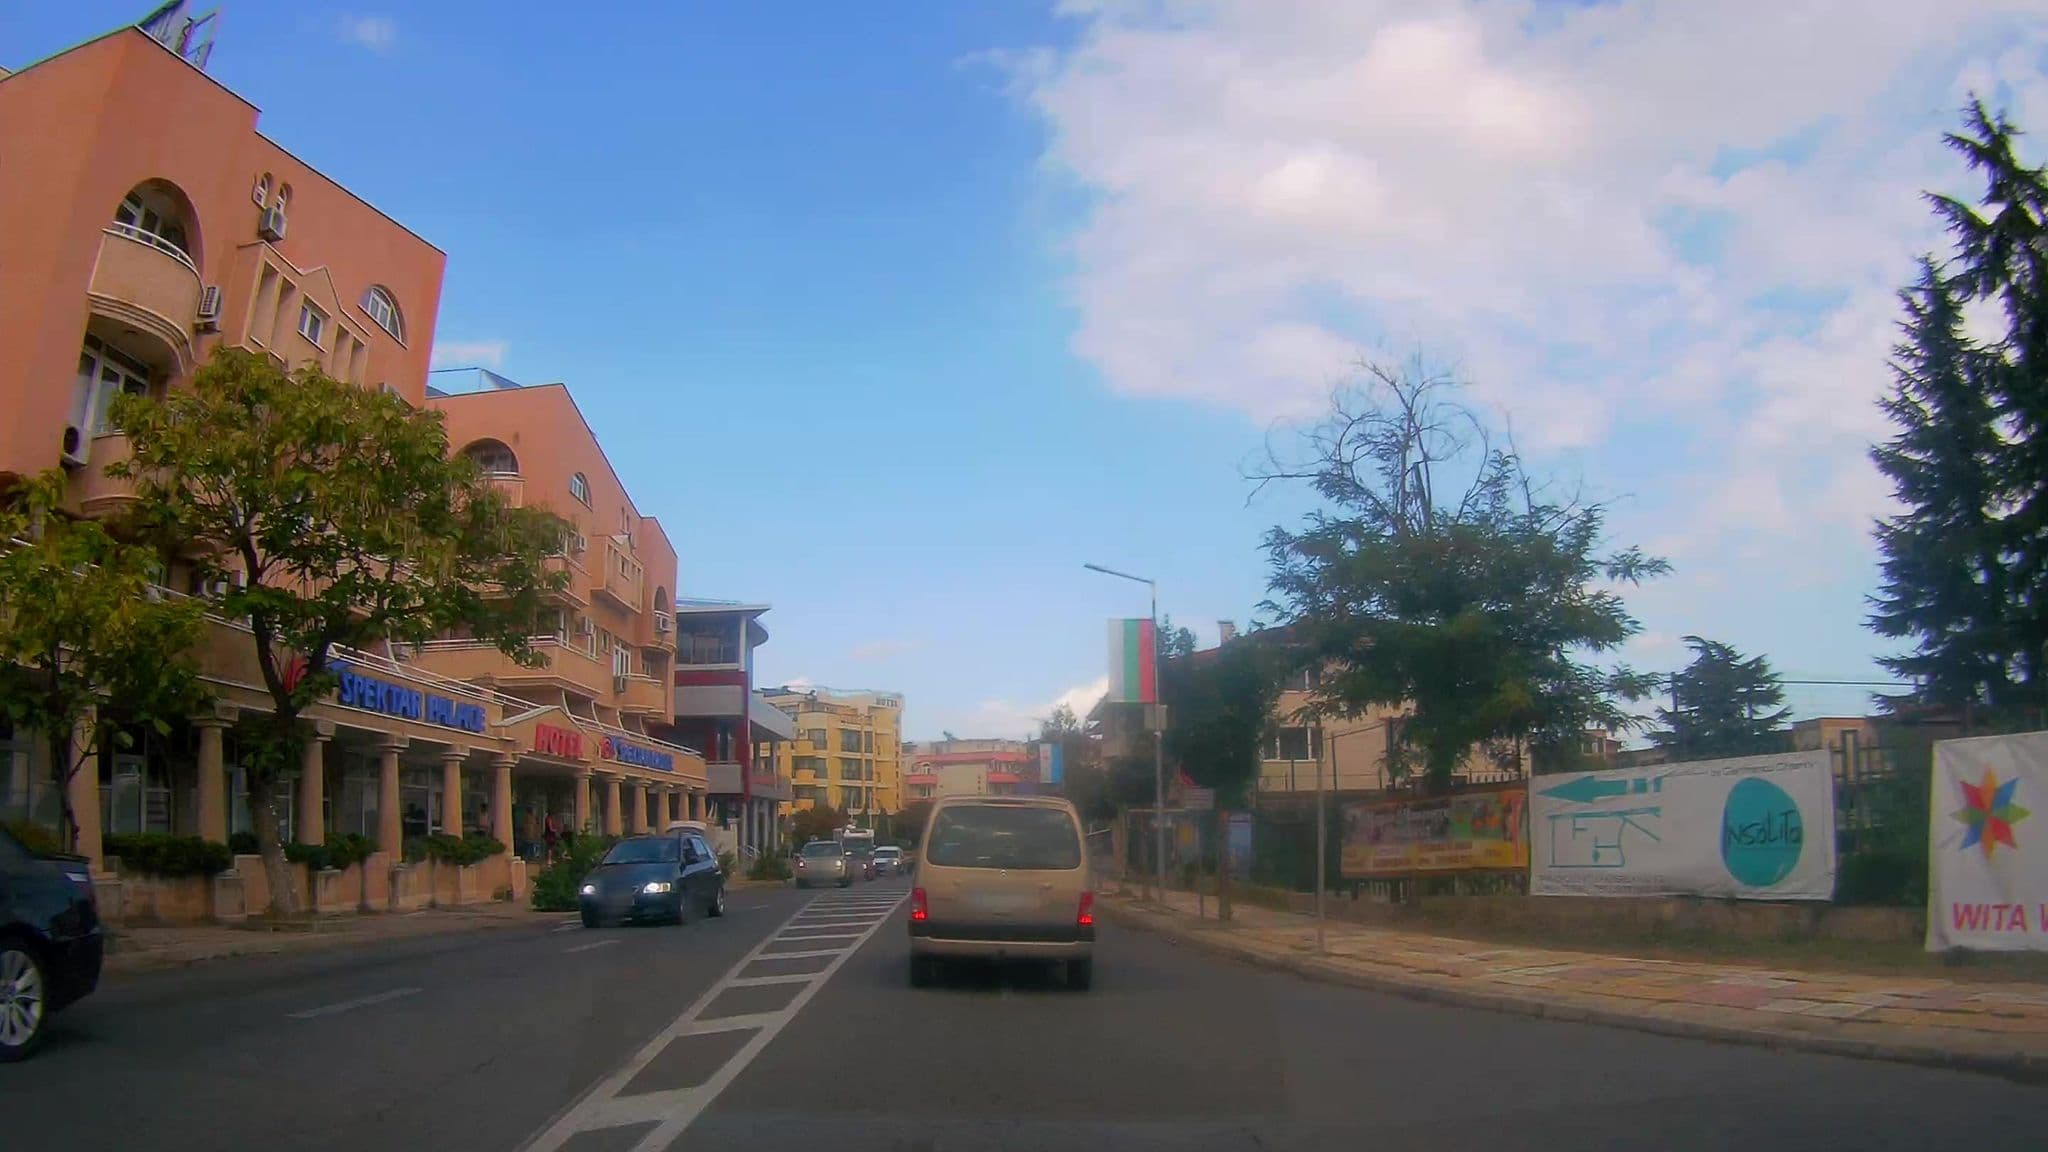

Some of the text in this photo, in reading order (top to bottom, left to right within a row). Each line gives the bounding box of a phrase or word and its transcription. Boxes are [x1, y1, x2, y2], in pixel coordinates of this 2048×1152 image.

[338, 671, 423, 719] SPEKTAR
[536, 723, 583, 758] HOTEL
[1952, 902, 2028, 933] WITA
